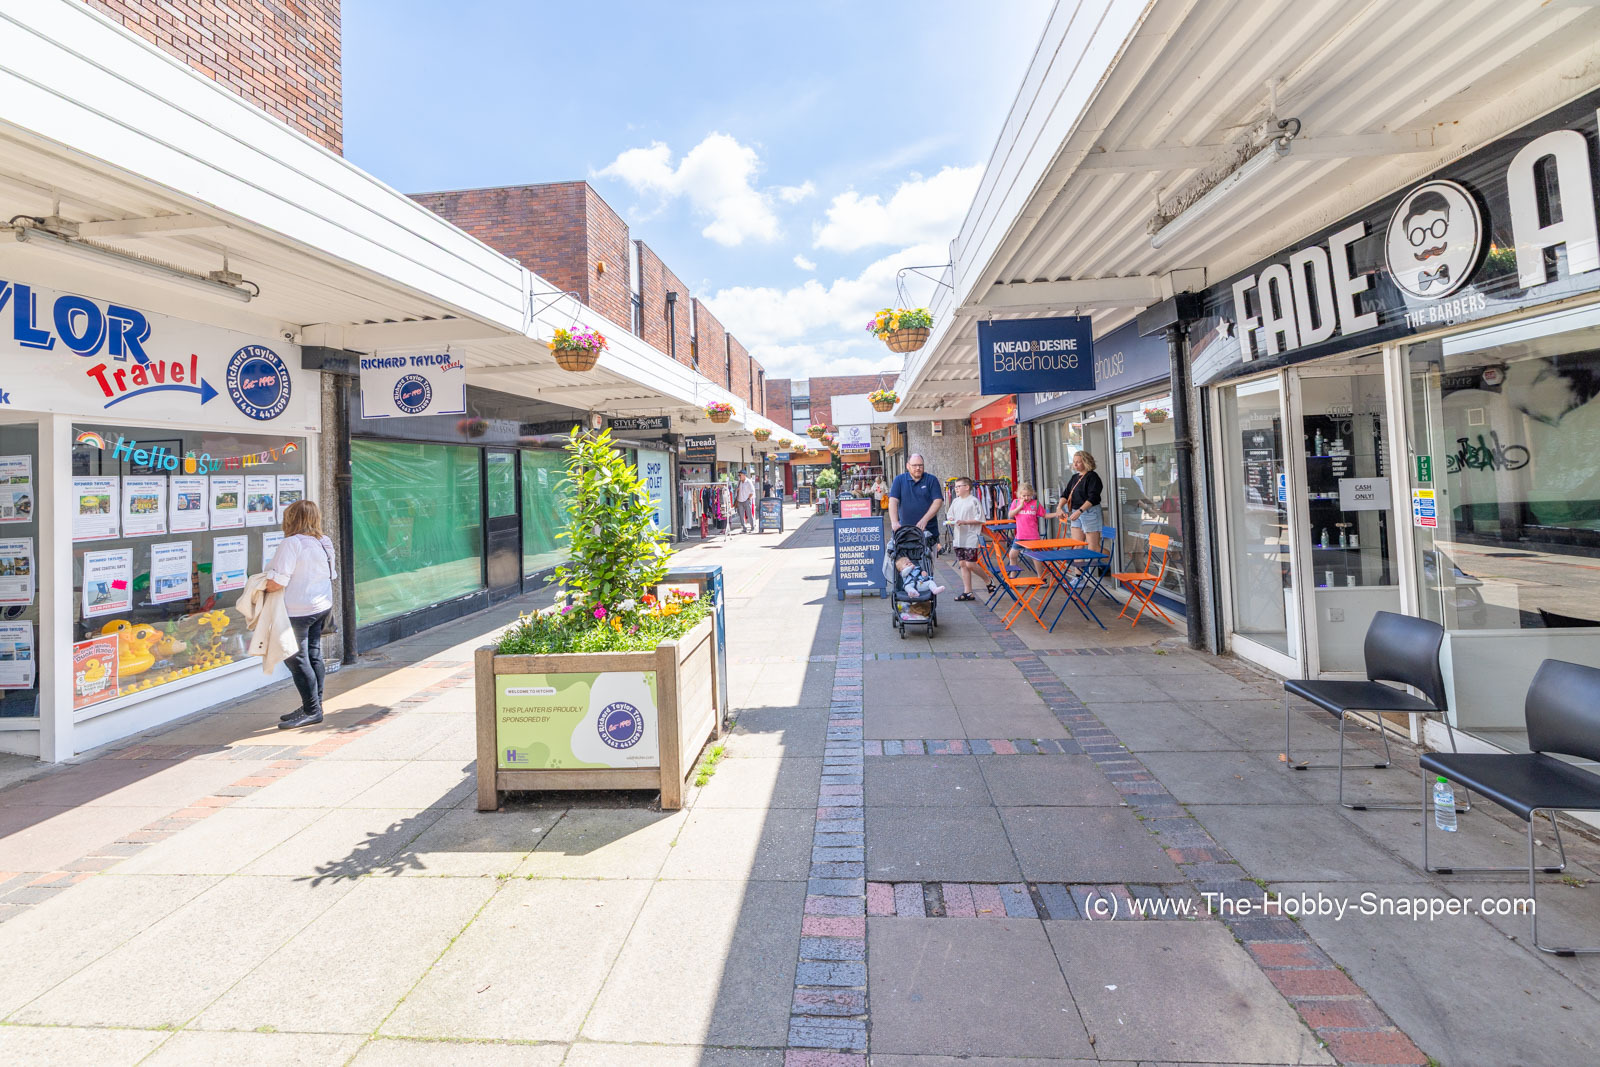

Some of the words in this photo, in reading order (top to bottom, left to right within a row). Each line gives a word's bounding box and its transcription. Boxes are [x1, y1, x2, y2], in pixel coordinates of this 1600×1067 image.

[1506, 108, 1600, 289] A
[1232, 221, 1378, 363] FADE
[1404, 307, 1428, 329] THE
[1430, 293, 1486, 322] BARBERS
[227, 350, 247, 389] Richard
[248, 346, 279, 364] Taylor
[278, 363, 290, 398] Travel
[361, 356, 407, 370] RICHARD
[409, 354, 451, 367] TAYLOR
[441, 360, 460, 371] Travel
[993, 353, 1078, 372] Bakehouse
[1094, 351, 1124, 383] ehouse
[87, 354, 198, 397] Travel
[394, 379, 405, 401] Richard
[233, 391, 257, 417] 01462
[259, 398, 286, 419] 442409
[685, 437, 716, 448] Threads
[112, 436, 179, 471] Hello
[198, 447, 280, 474] Summer
[647, 462, 661, 475] SHOP
[1420, 456, 1429, 481] PUSH
[654, 476, 663, 489] LET
[838, 533, 880, 543] Bakehouse
[840, 558, 874, 566] SOURDOUGH
[553, 705, 584, 713] PROUDLY
[599, 707, 611, 732] Richard
[611, 703, 633, 711] Taylor
[633, 710, 643, 732] Travel
